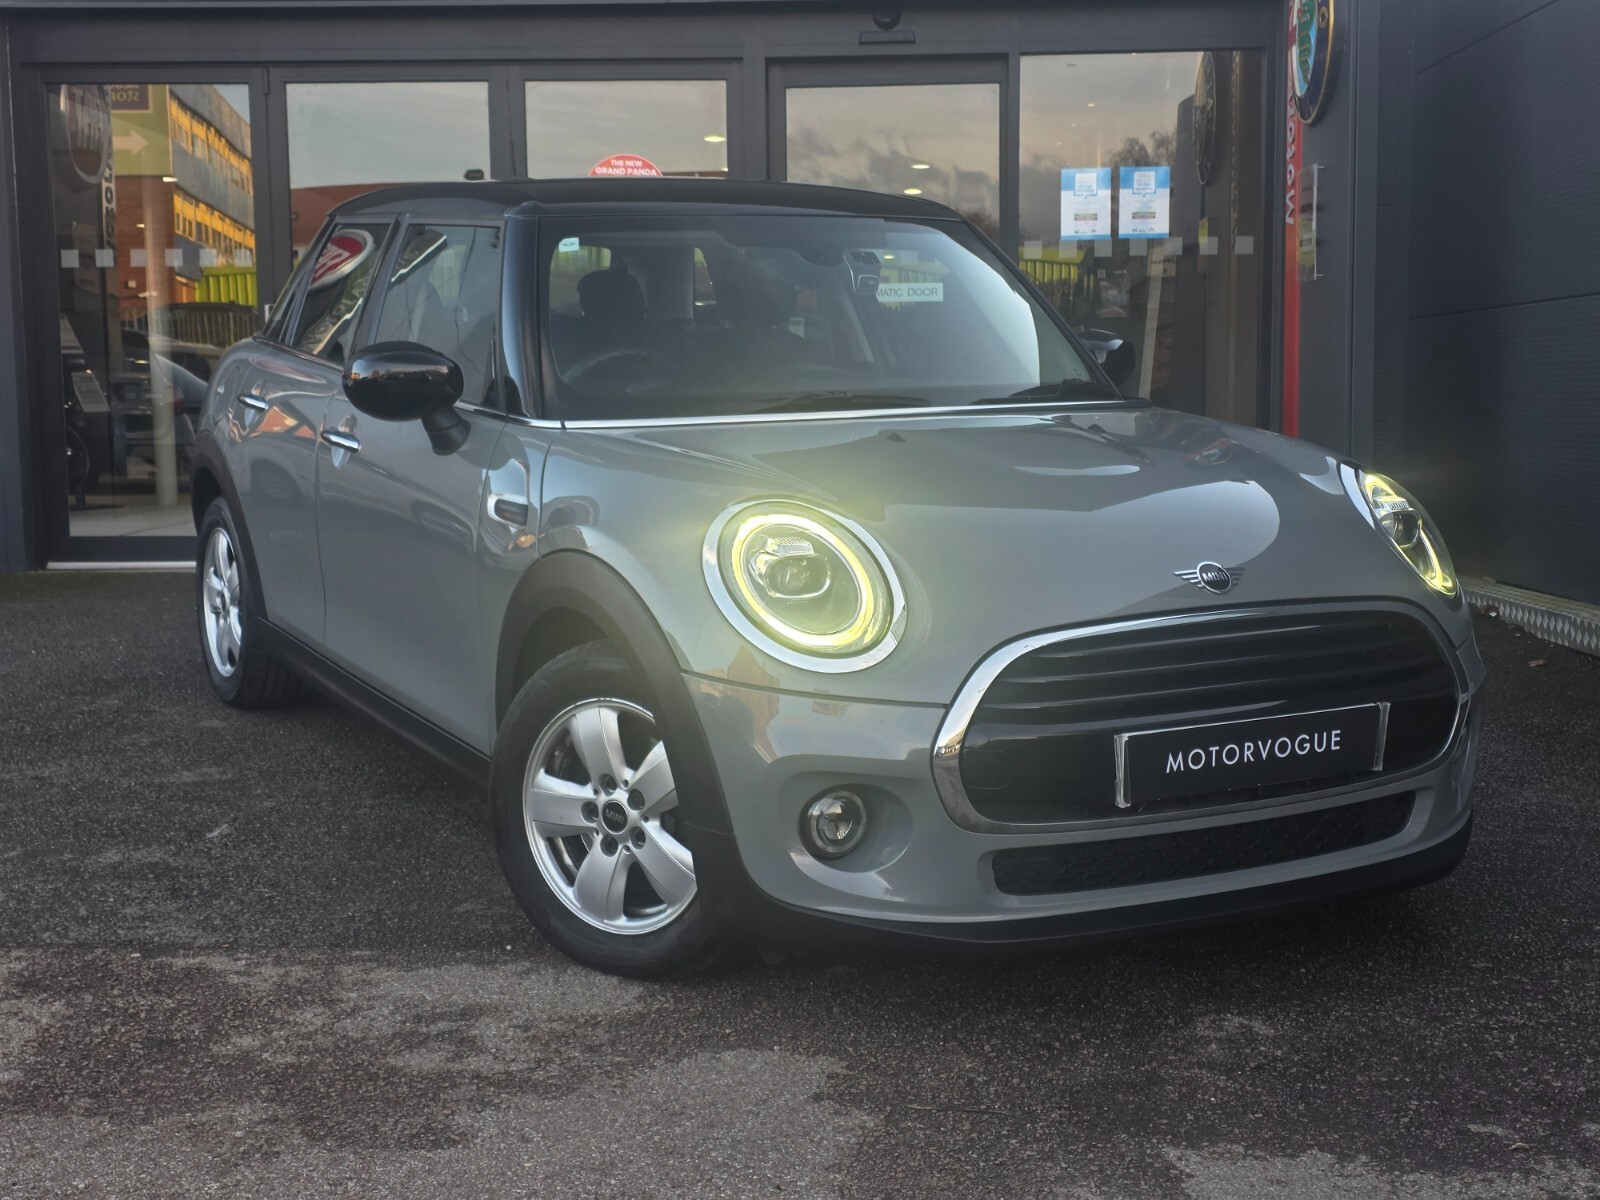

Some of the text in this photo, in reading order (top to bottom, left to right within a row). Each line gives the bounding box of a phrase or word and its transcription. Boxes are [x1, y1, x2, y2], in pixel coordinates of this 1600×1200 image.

[595, 167, 657, 176] GRAND PANDA
[907, 287, 938, 297] DOOR
[1201, 571, 1228, 582] MINI
[1165, 729, 1341, 774] MOTORVOGUE
